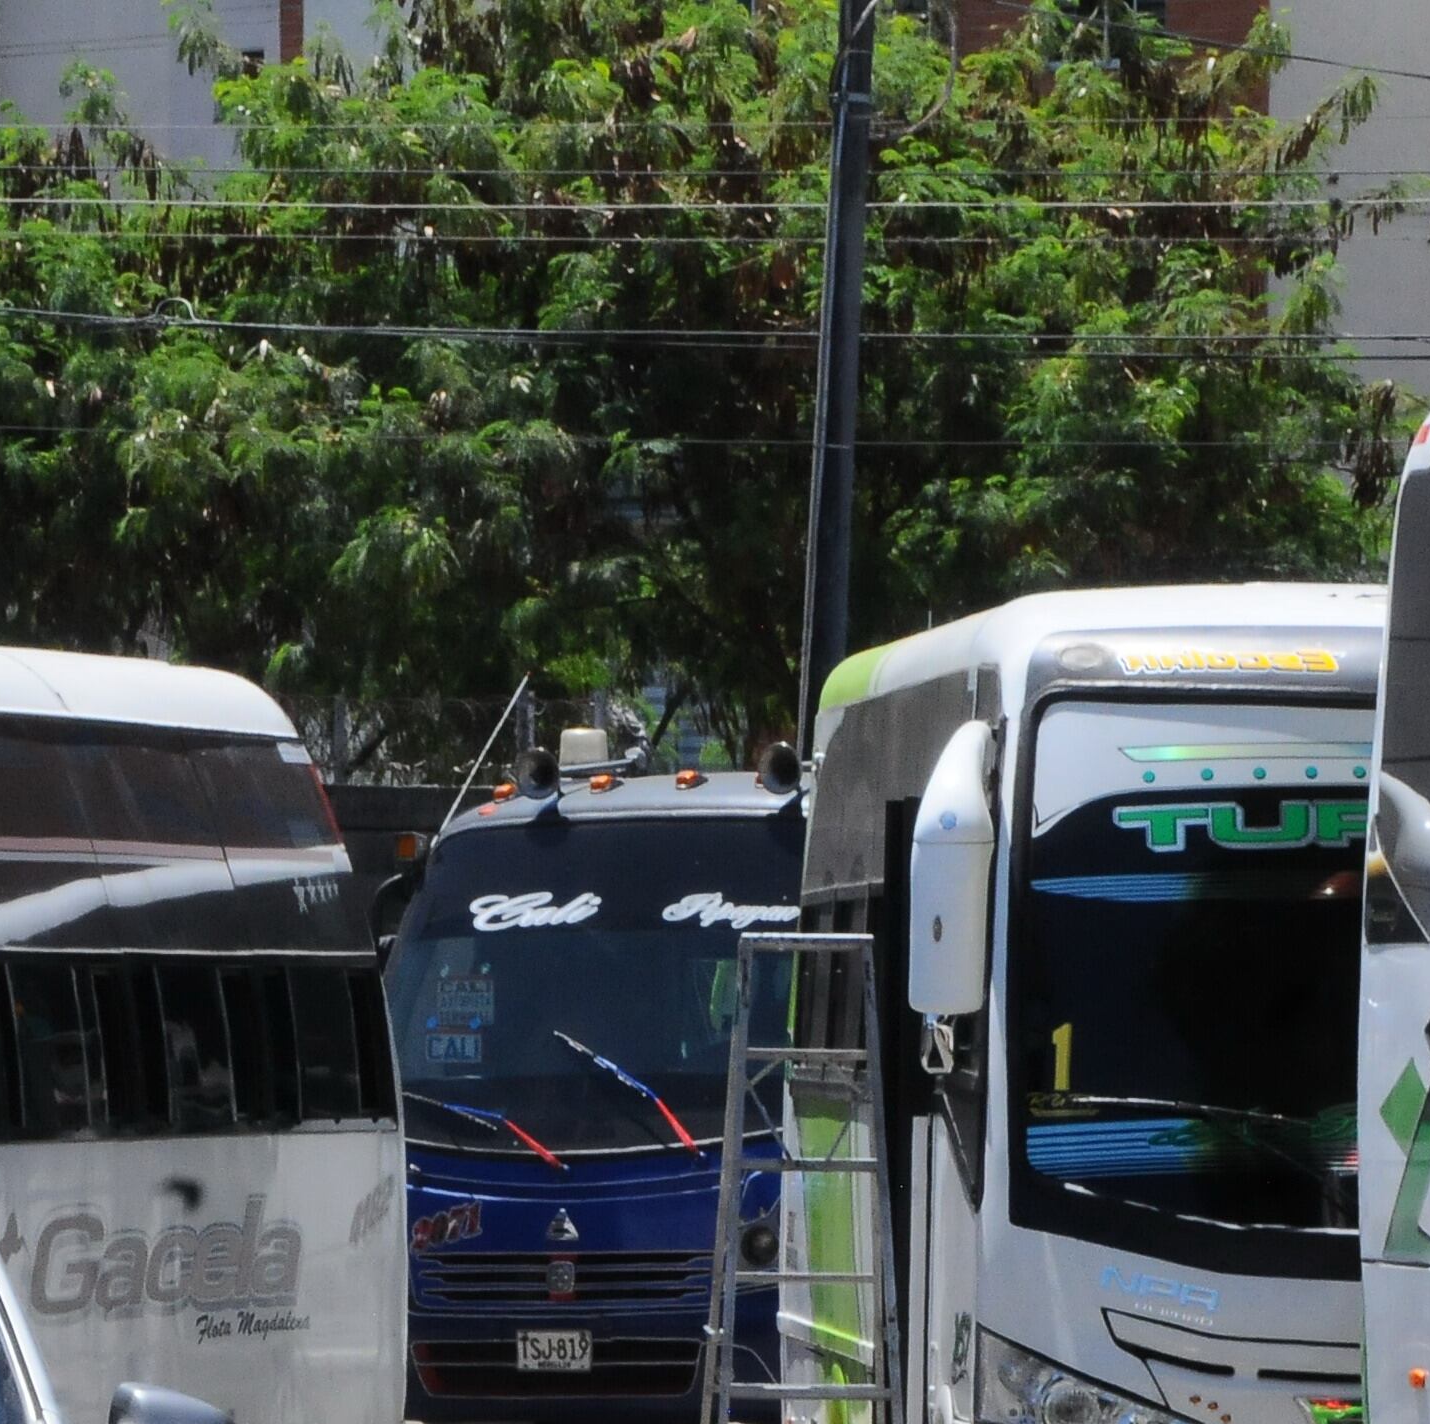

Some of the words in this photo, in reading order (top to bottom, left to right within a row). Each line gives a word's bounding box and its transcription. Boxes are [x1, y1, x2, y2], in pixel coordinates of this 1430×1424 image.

[470, 891, 602, 931] Cali
[29, 1192, 303, 1320] Gacela
[1099, 1264, 1221, 1313] NPR
[195, 1312, 231, 1344] Flota
[237, 1310, 312, 1341] Magdalena
